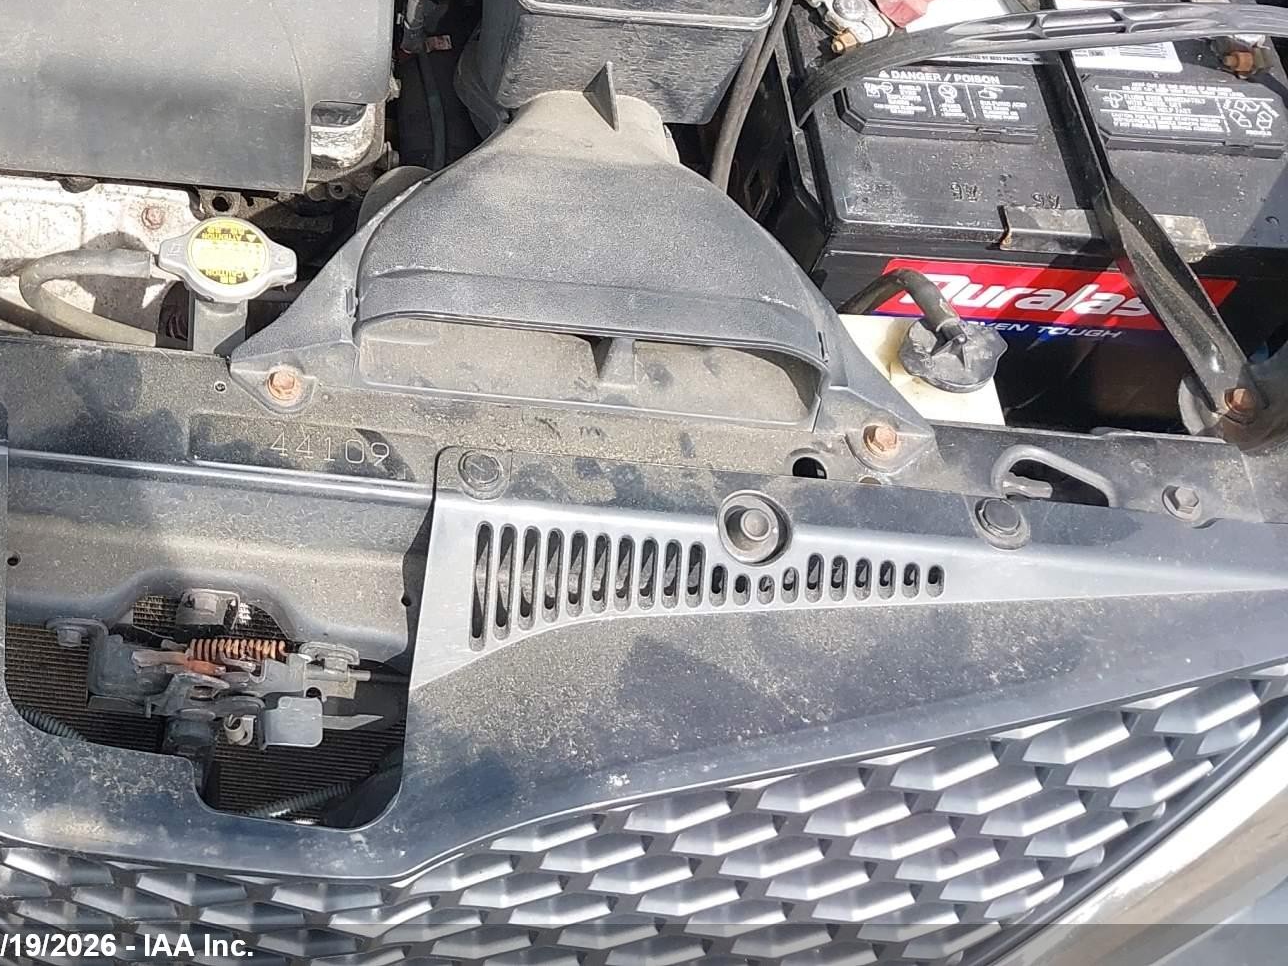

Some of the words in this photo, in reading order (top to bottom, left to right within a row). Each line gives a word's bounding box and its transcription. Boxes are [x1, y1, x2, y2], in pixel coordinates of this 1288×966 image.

[890, 70, 942, 82] DANGER
[953, 73, 1000, 85] POISON
[899, 273, 1151, 317] Duralas
[1037, 325, 1123, 339] TOUGH
[269, 430, 391, 467] 44109
